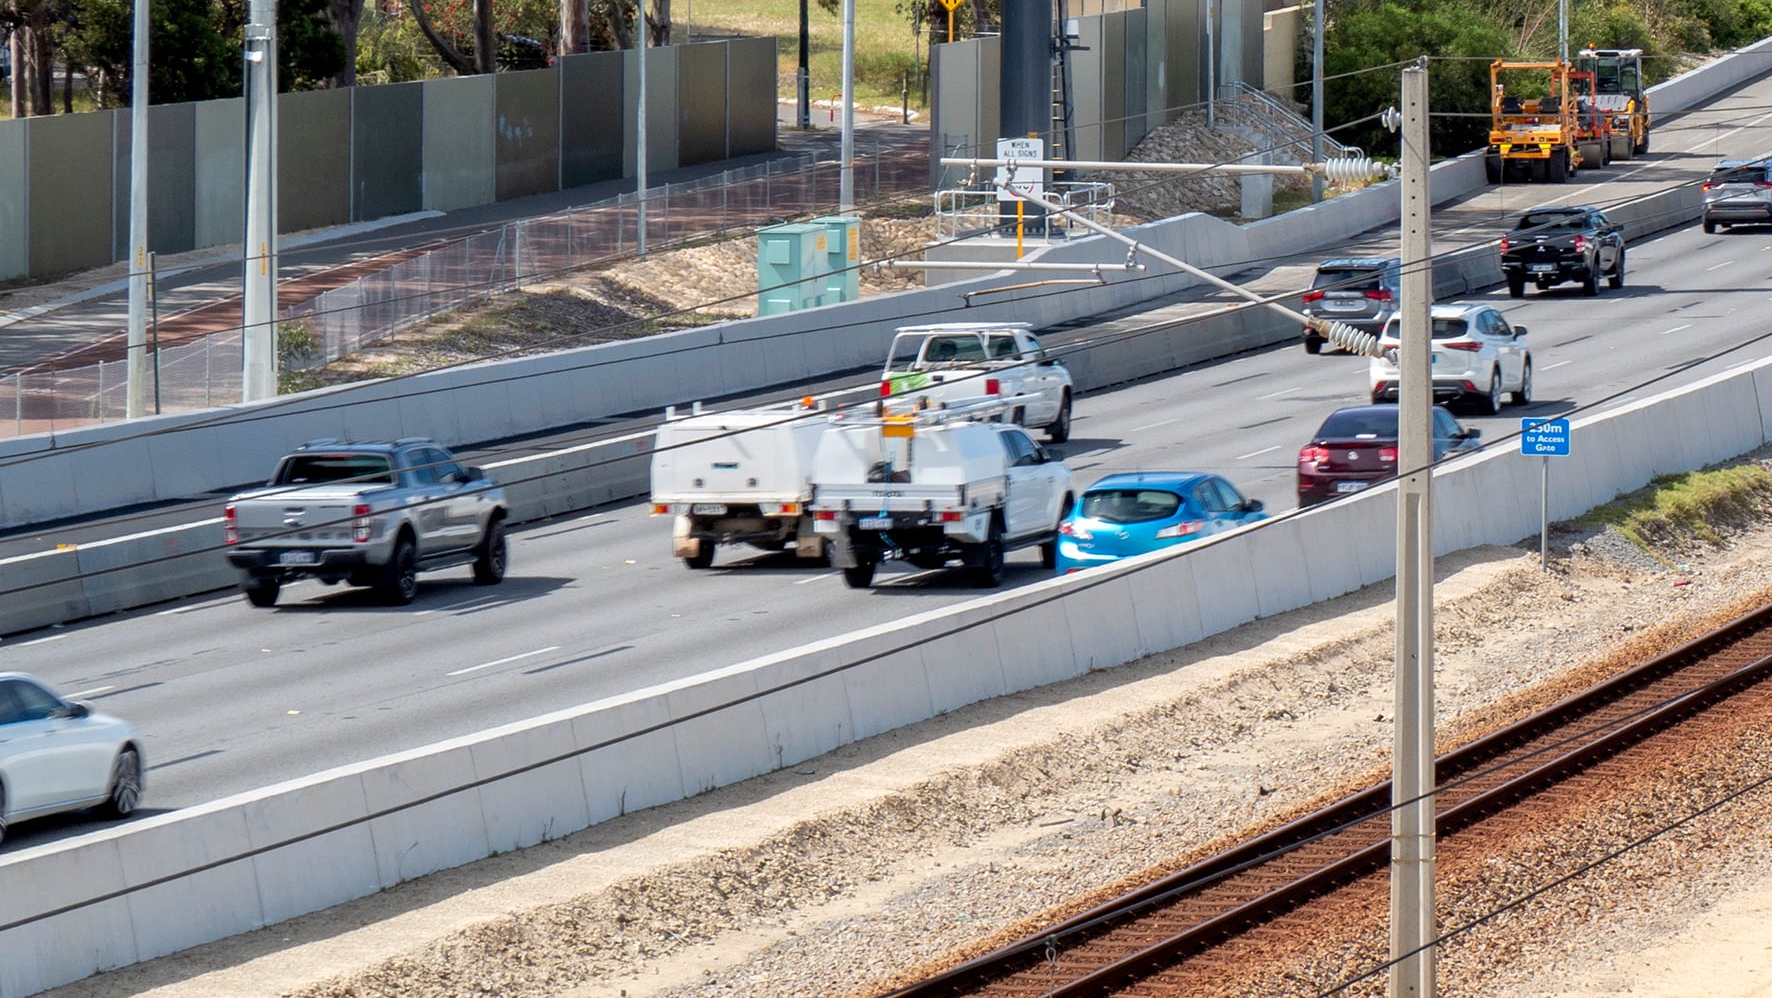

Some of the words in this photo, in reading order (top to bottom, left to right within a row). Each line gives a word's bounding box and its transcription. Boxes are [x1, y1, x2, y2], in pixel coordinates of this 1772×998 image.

[1017, 150, 1037, 158] SIGNS
[1537, 435, 1565, 443] Access
[1535, 443, 1556, 452] Gate
